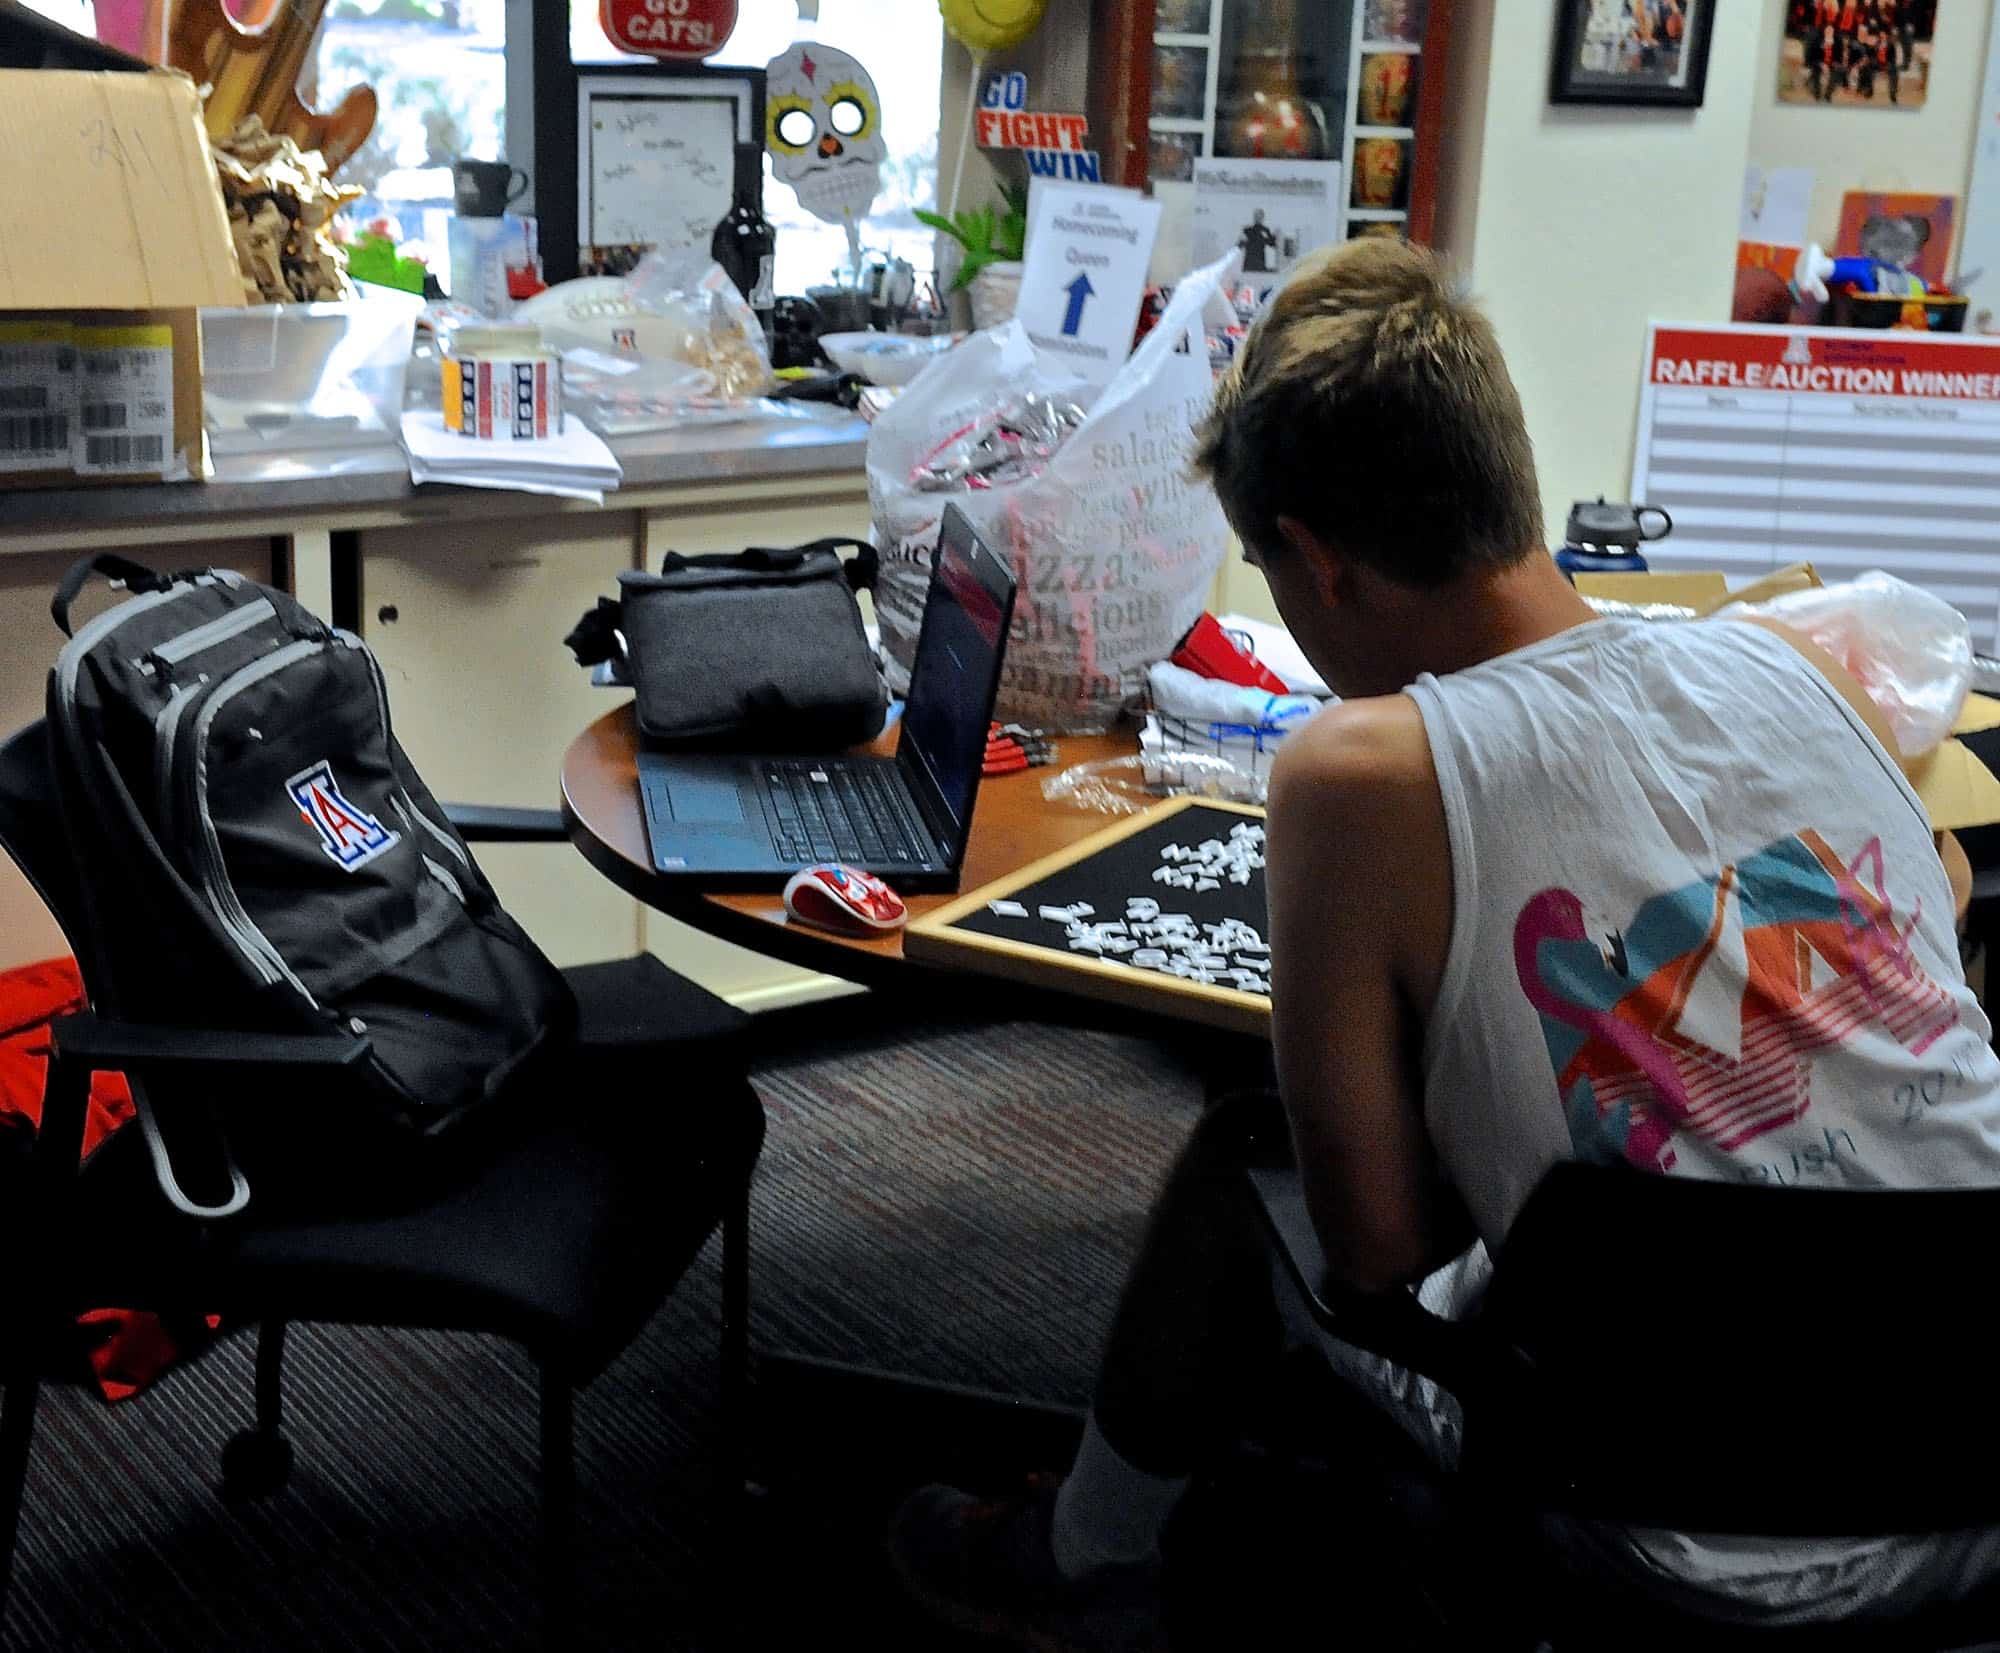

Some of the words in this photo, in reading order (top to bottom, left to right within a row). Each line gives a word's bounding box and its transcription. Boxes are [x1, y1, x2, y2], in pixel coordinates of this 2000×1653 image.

[645, 0, 690, 16] GO
[626, 14, 715, 45] CATS!
[980, 73, 1026, 110] GO
[976, 110, 1087, 151] FIGHT
[1026, 150, 1100, 183] WIN
